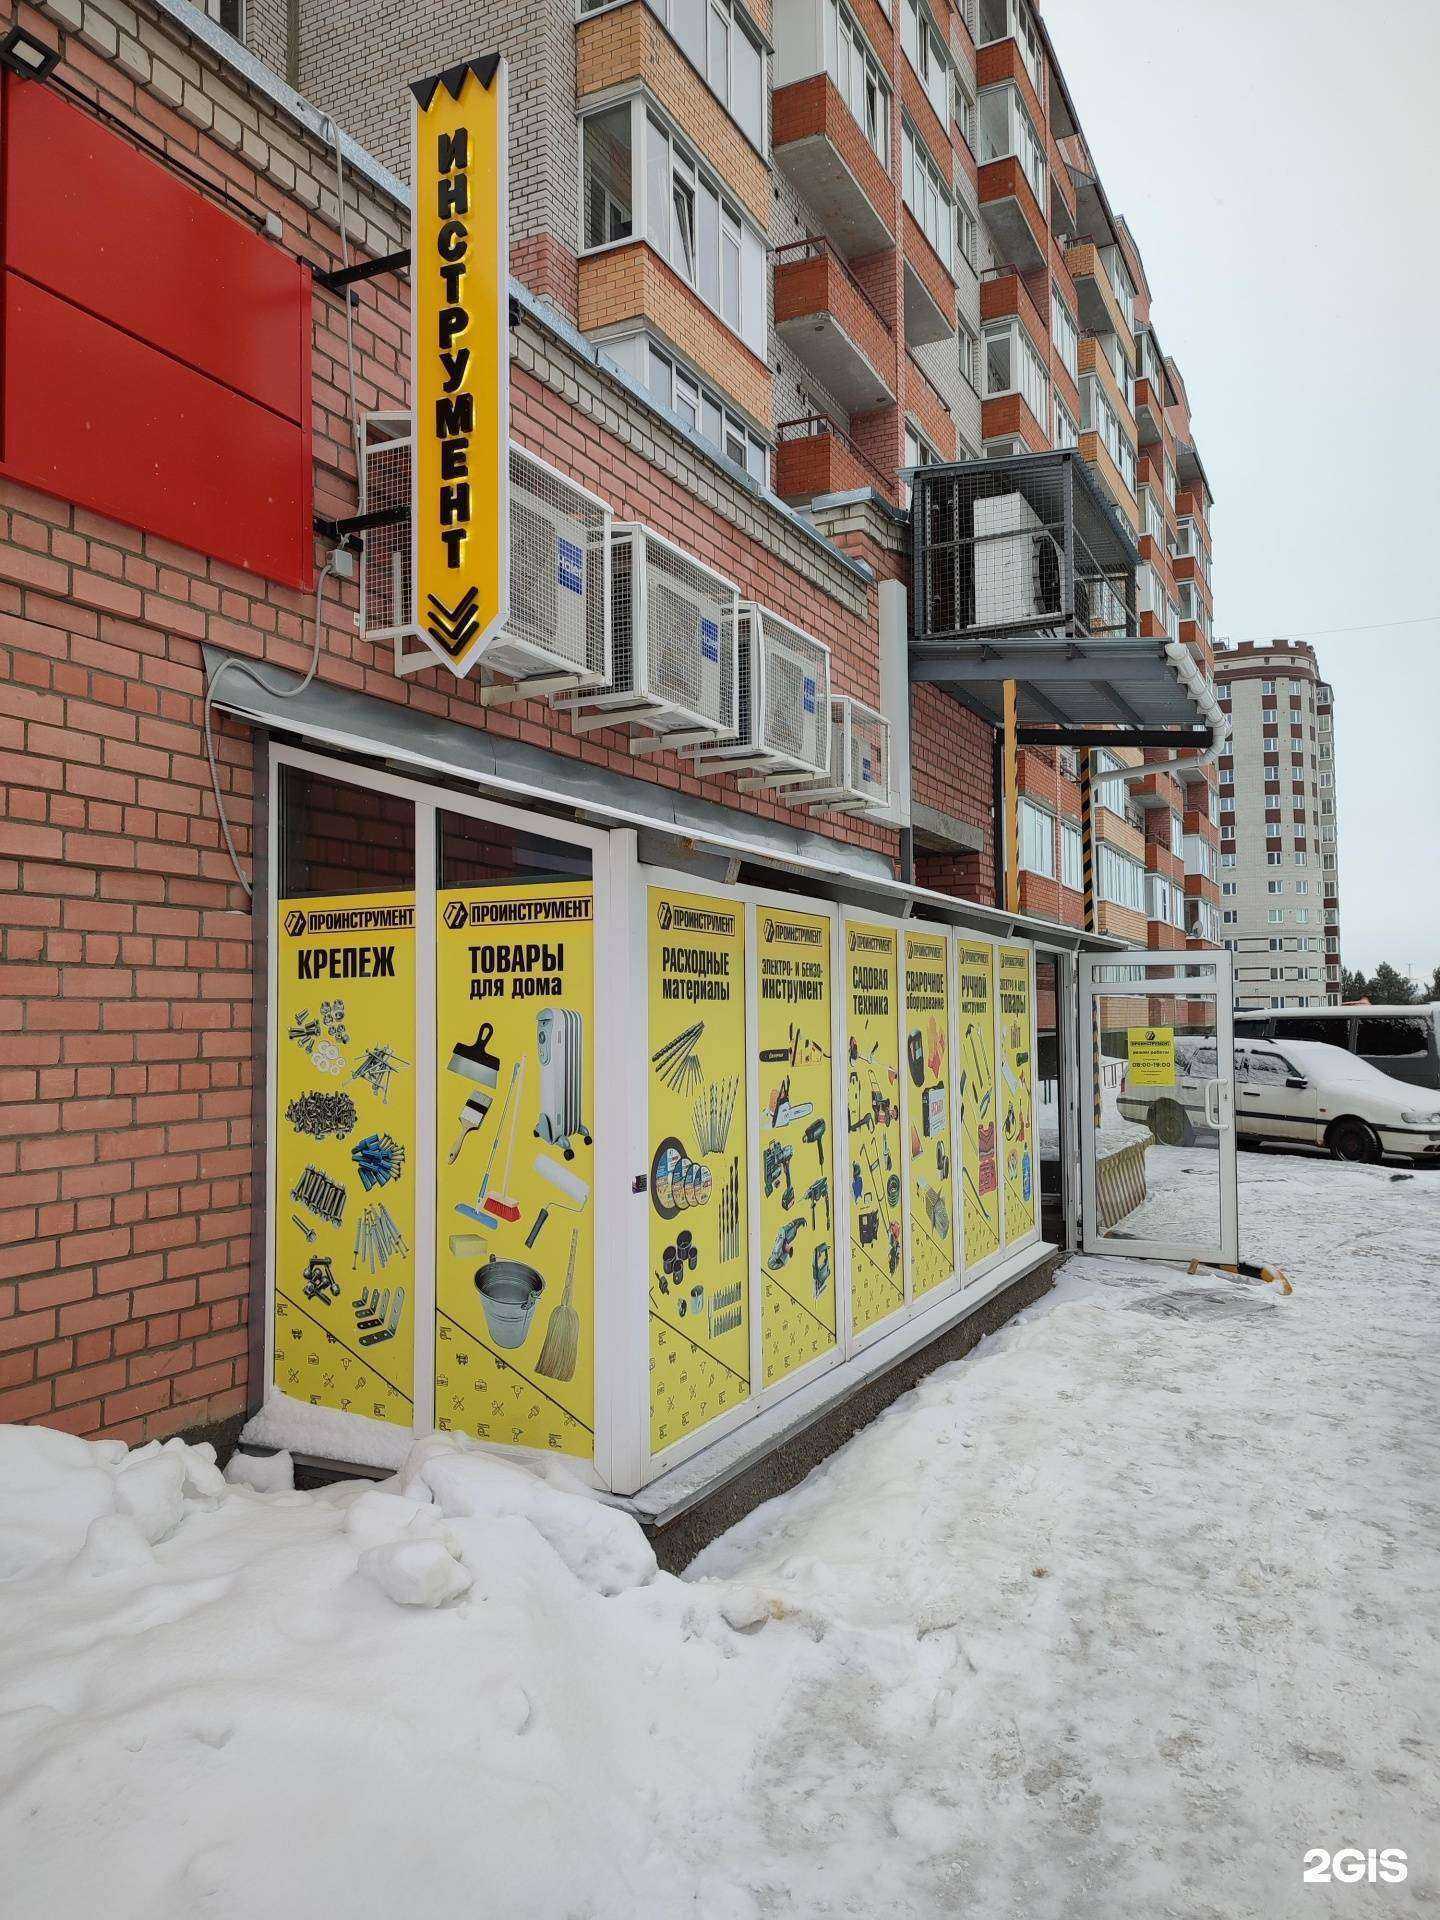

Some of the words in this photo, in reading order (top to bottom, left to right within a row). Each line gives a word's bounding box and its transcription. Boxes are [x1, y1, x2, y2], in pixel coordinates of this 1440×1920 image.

[436, 127, 474, 570] ИНСТРУМЕНТ
[309, 907, 415, 931] ПРОИНСТРУМЕНТ
[471, 899, 591, 924] ПРОИНСТРУМЕНТ
[673, 909, 734, 933] ПРОИНСТРУМЕНТ
[297, 946, 396, 980] КРЕПЕЖ
[468, 943, 564, 974] ТОВАРЫ
[662, 947, 730, 977] РАСХОДНЫЕ
[470, 978, 504, 1000] для
[512, 975, 563, 1000] дома
[852, 966, 889, 992] САДОВАЯ
[906, 971, 944, 994] СВАРОЧНОЕ
[962, 973, 987, 999] РУЧНОЙ
